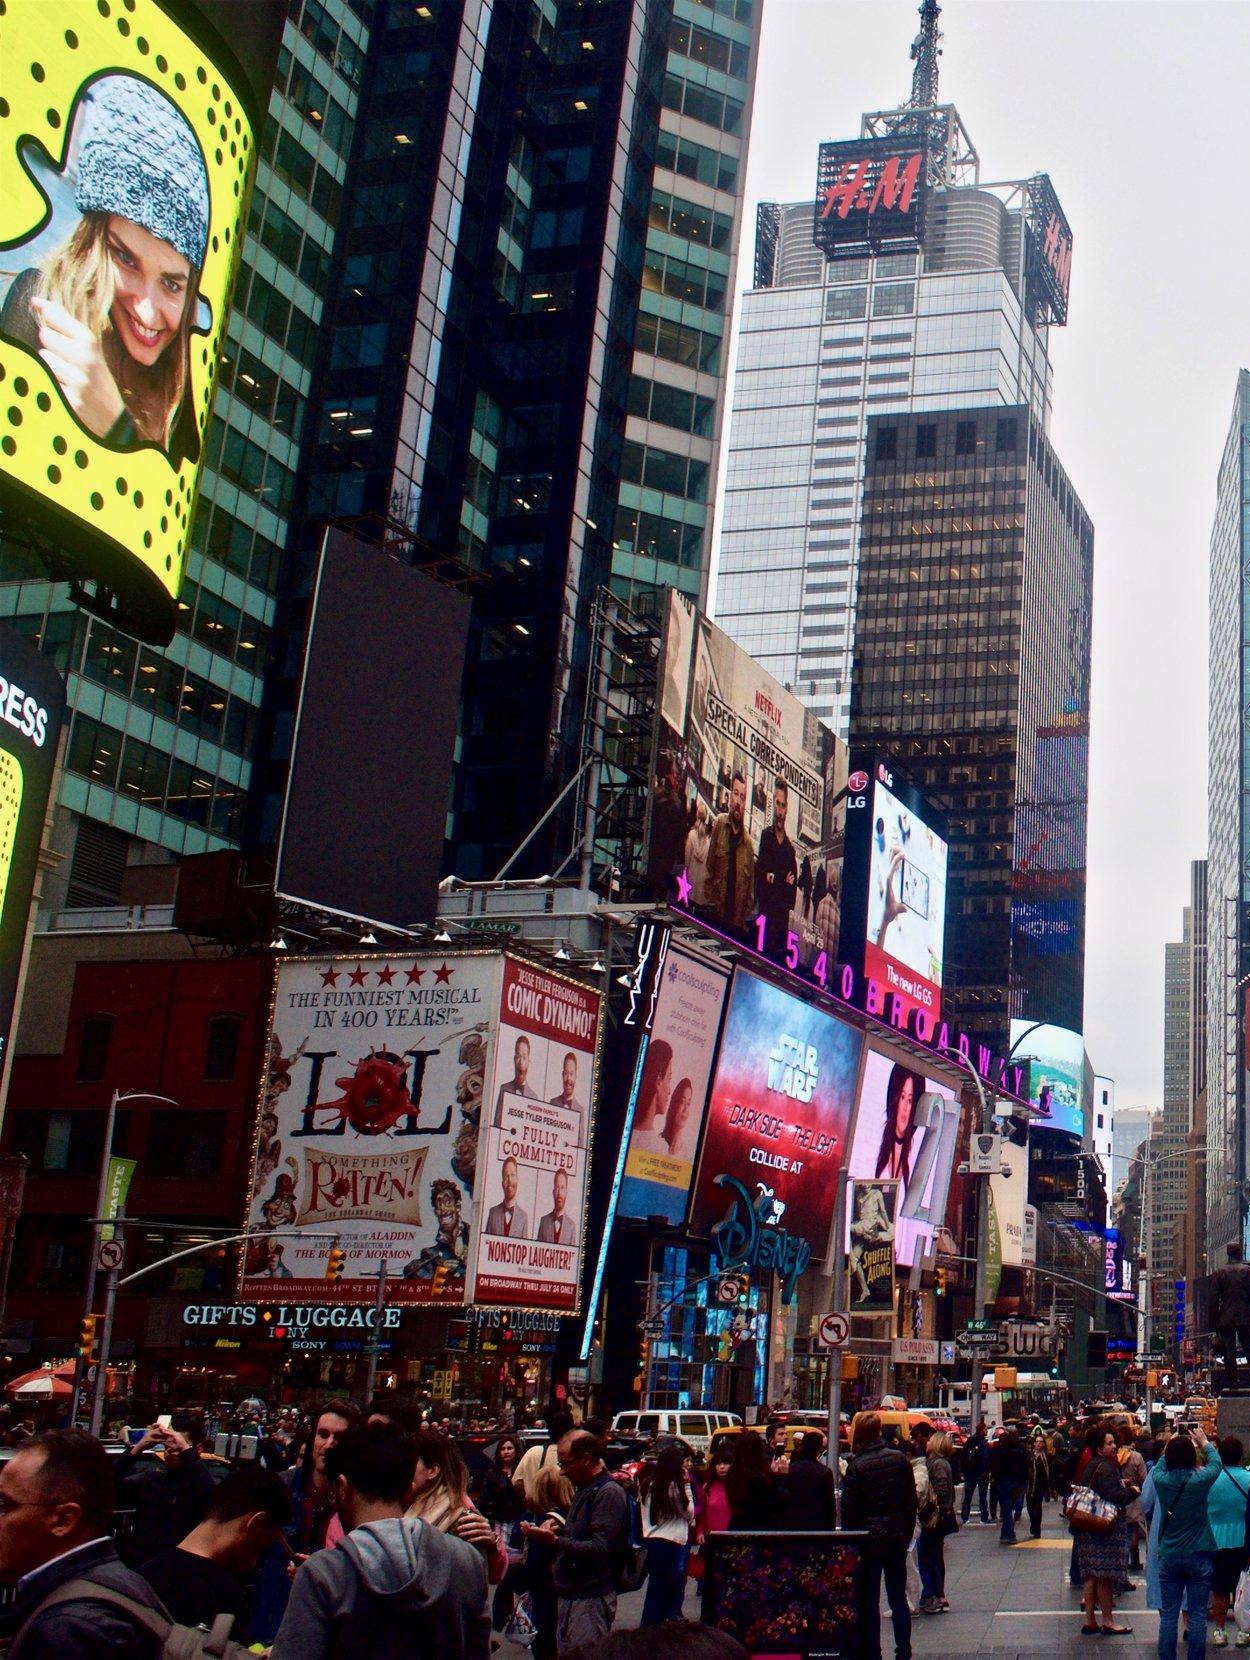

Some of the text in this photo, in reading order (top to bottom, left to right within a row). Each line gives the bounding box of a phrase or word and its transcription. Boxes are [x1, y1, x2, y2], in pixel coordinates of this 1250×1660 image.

[820, 154, 922, 219] H&M
[755, 690, 782, 728] NETFLIX
[708, 698, 748, 748] SPECIAL
[750, 732, 817, 801] CORRESPONDENTS
[847, 797, 866, 808] LG
[468, 920, 517, 932] LAMAR
[755, 914, 853, 999] 1540
[536, 977, 578, 1002] TYLER FERGUSON
[887, 964, 932, 1007] The new LG G5
[288, 988, 481, 1008] THE FUNNIEST MUSICAL
[507, 983, 541, 1022] COMIC
[314, 1011, 336, 1028] IN
[341, 1010, 378, 1028] 400
[769, 1033, 819, 1077] STAR
[767, 1062, 818, 1103] WARS
[507, 1108, 571, 1131] JESSE TYLER FERGUSON
[729, 1104, 762, 1132] DARK
[760, 1114, 783, 1139] SIDE
[810, 1133, 837, 1157] LIGHT
[523, 1125, 558, 1147] FULLY
[320, 1154, 410, 1168] SOMETHING
[502, 1140, 574, 1169] COMMITTED
[750, 1148, 803, 1174] COLLIDE AT
[110, 1166, 125, 1219] TASTE
[370, 1231, 416, 1241] ALADDIN
[296, 1250, 411, 1259] THE OF MORMON
[862, 1247, 890, 1268] SHUFFLE
[867, 1263, 890, 1284] ALONG
[479, 1278, 489, 1286] ON
[489, 1279, 522, 1289] BROADWAY
[524, 1282, 538, 1291] THRU
[539, 1283, 551, 1292] JULY
[560, 1286, 574, 1294] ONLY
[183, 1306, 256, 1325] GIFTS
[466, 1308, 561, 1332] GIFTS LUGGAGE
[215, 1339, 241, 1348] Nikon
[287, 1327, 309, 1338] NY
[292, 1341, 327, 1349] SONY
[522, 1344, 541, 1352] SONY
